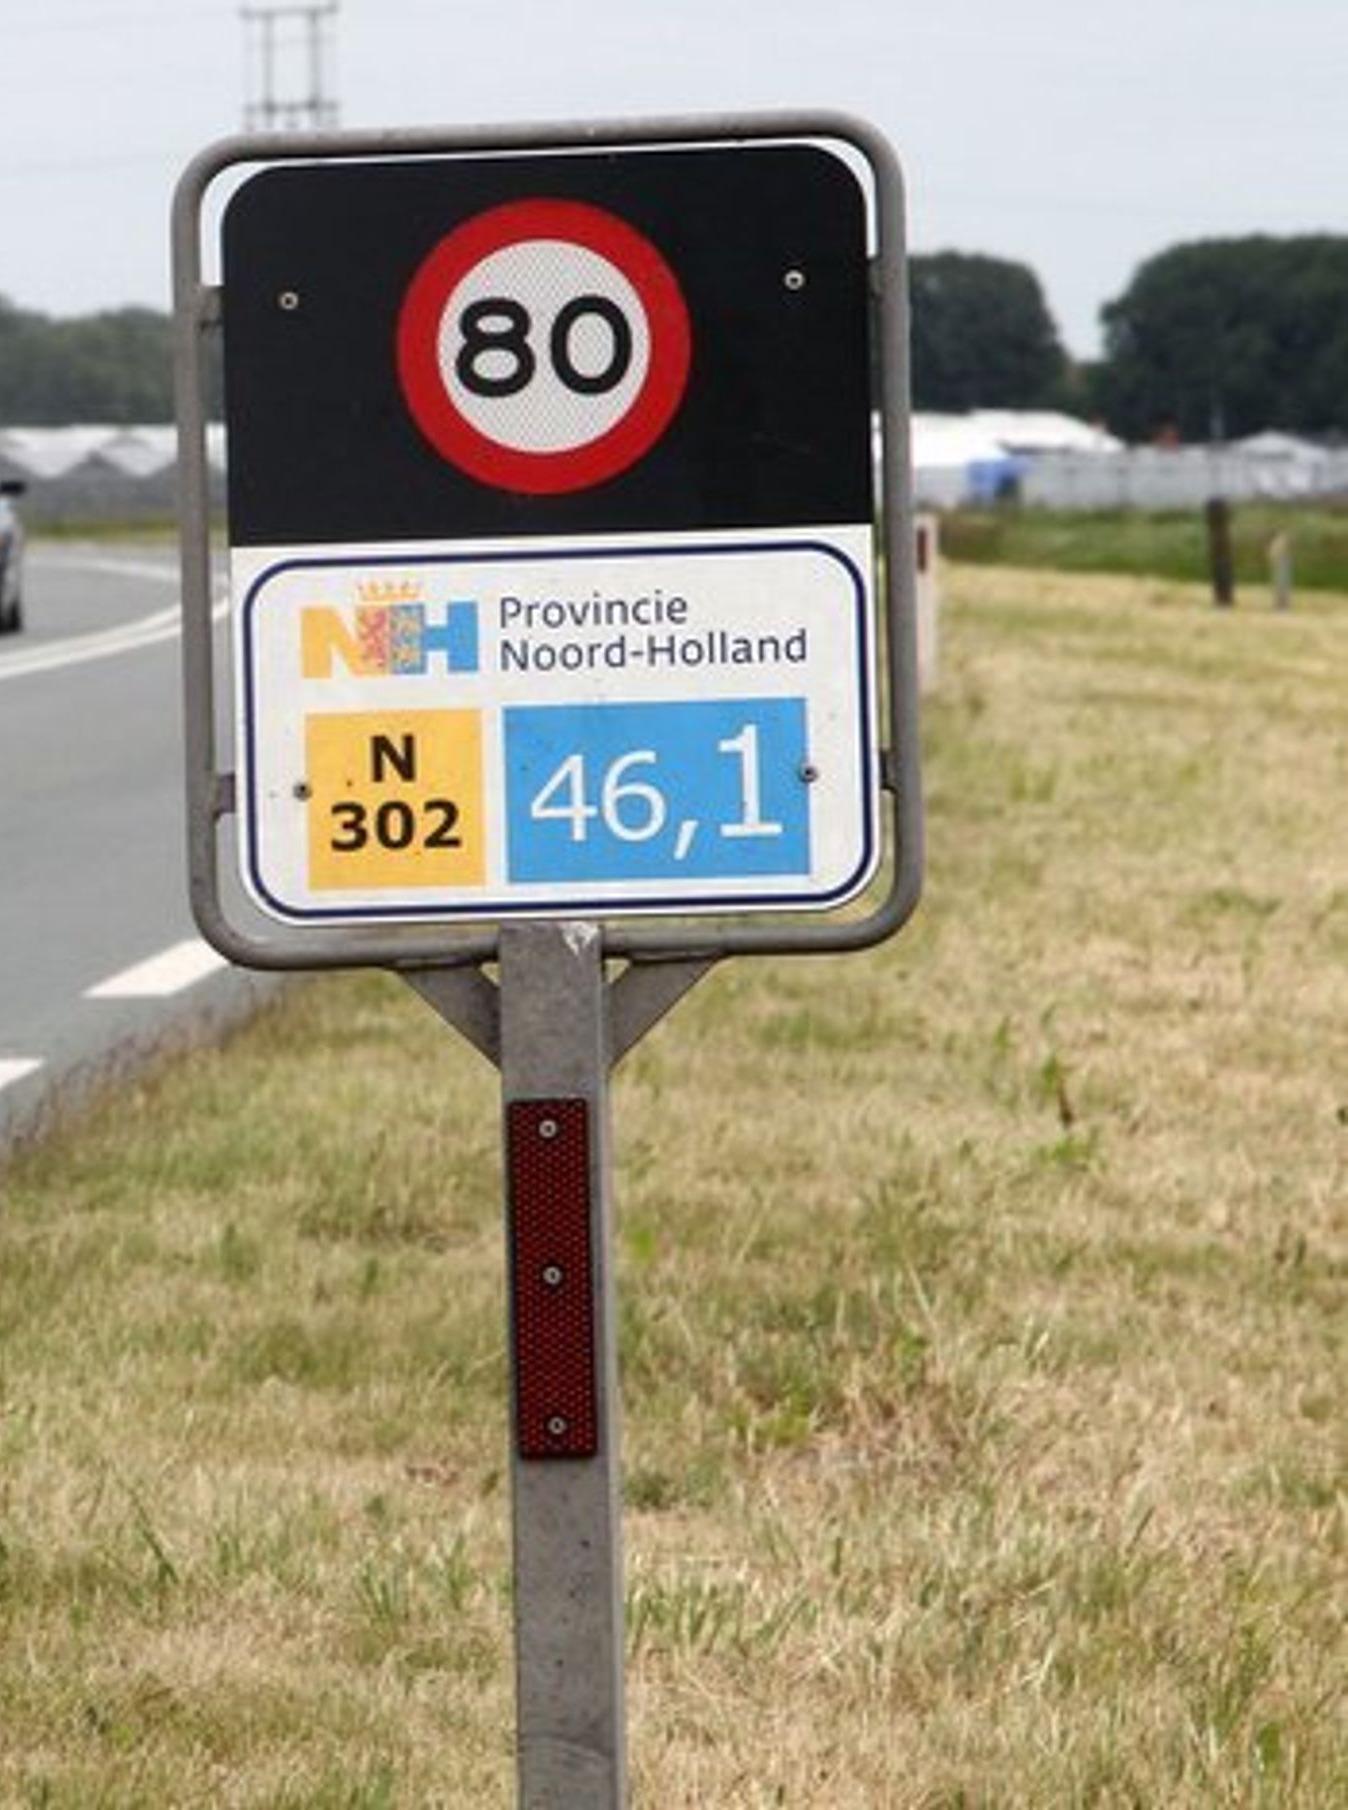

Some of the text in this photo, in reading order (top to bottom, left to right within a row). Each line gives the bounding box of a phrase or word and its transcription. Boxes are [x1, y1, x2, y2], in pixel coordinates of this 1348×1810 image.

[455, 294, 633, 398] 80
[499, 589, 689, 630] Provincie
[300, 600, 480, 680] NH
[499, 629, 808, 673] Noord-Holland
[370, 733, 417, 783] N
[530, 724, 784, 861] 46,1
[330, 800, 462, 852] 302
